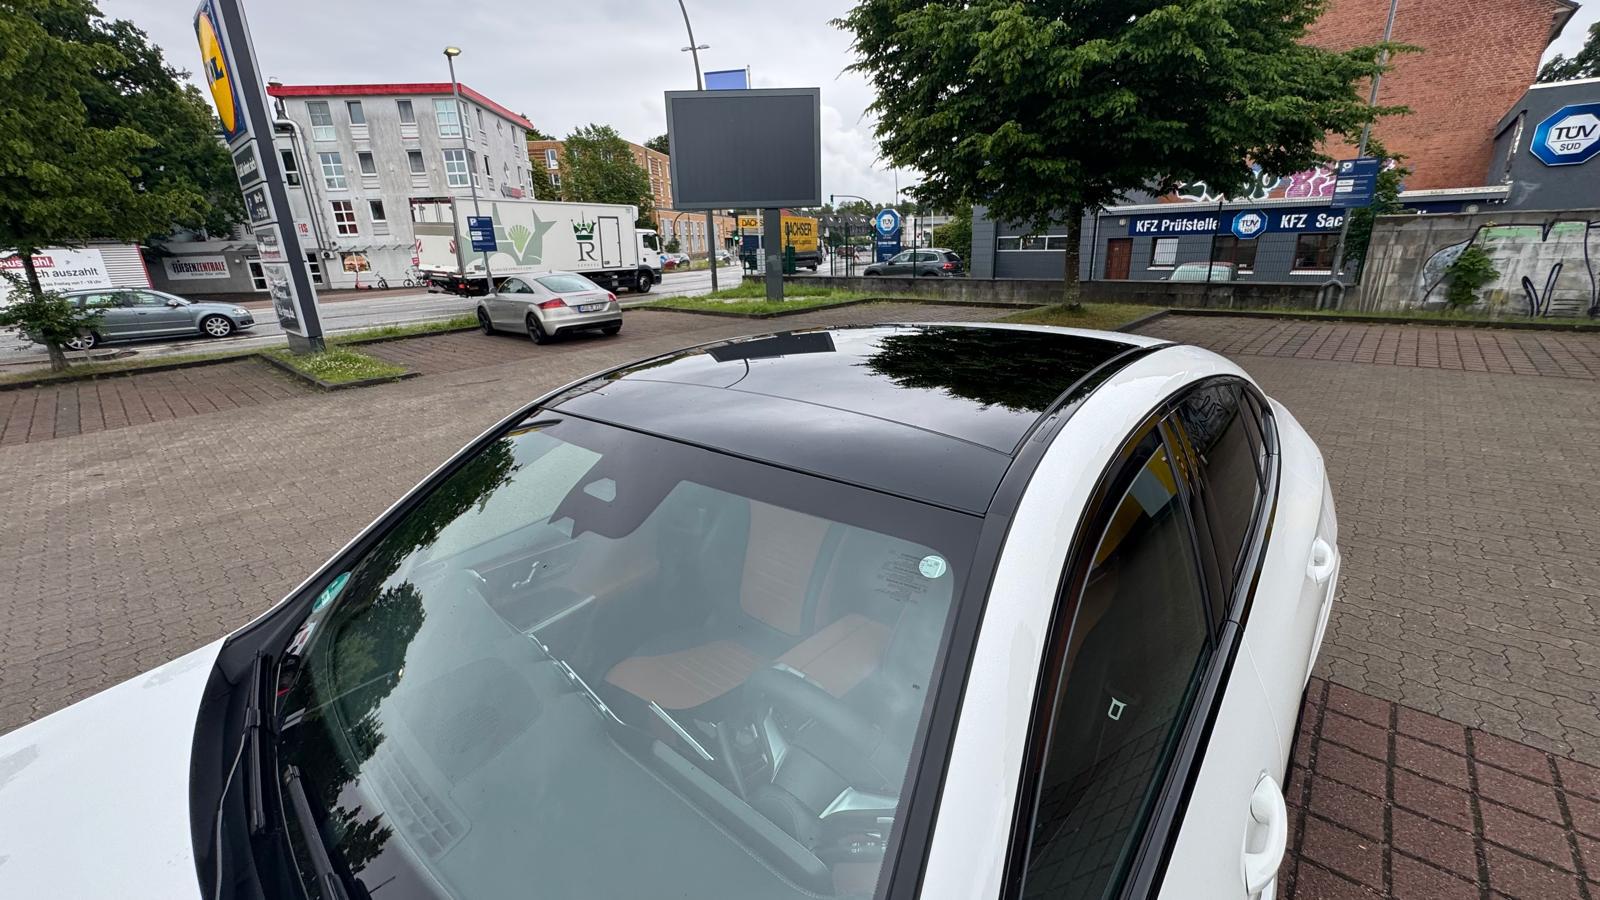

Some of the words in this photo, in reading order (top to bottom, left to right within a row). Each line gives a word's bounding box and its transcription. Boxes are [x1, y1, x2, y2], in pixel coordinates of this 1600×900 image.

[1555, 124, 1598, 140] TÜV
[1560, 142, 1581, 152] SÜD
[1136, 220, 1159, 232] KFZ
[1161, 218, 1220, 232] Prüfstelle
[1241, 218, 1260, 228] TÜV
[1280, 214, 1307, 229] KFZ
[1315, 213, 1344, 228] Sac
[576, 241, 598, 262] R
[0, 257, 54, 268] Ausahl.
[172, 261, 226, 274] FLIESENZENTRALE
[52, 267, 99, 277] auszahlt
